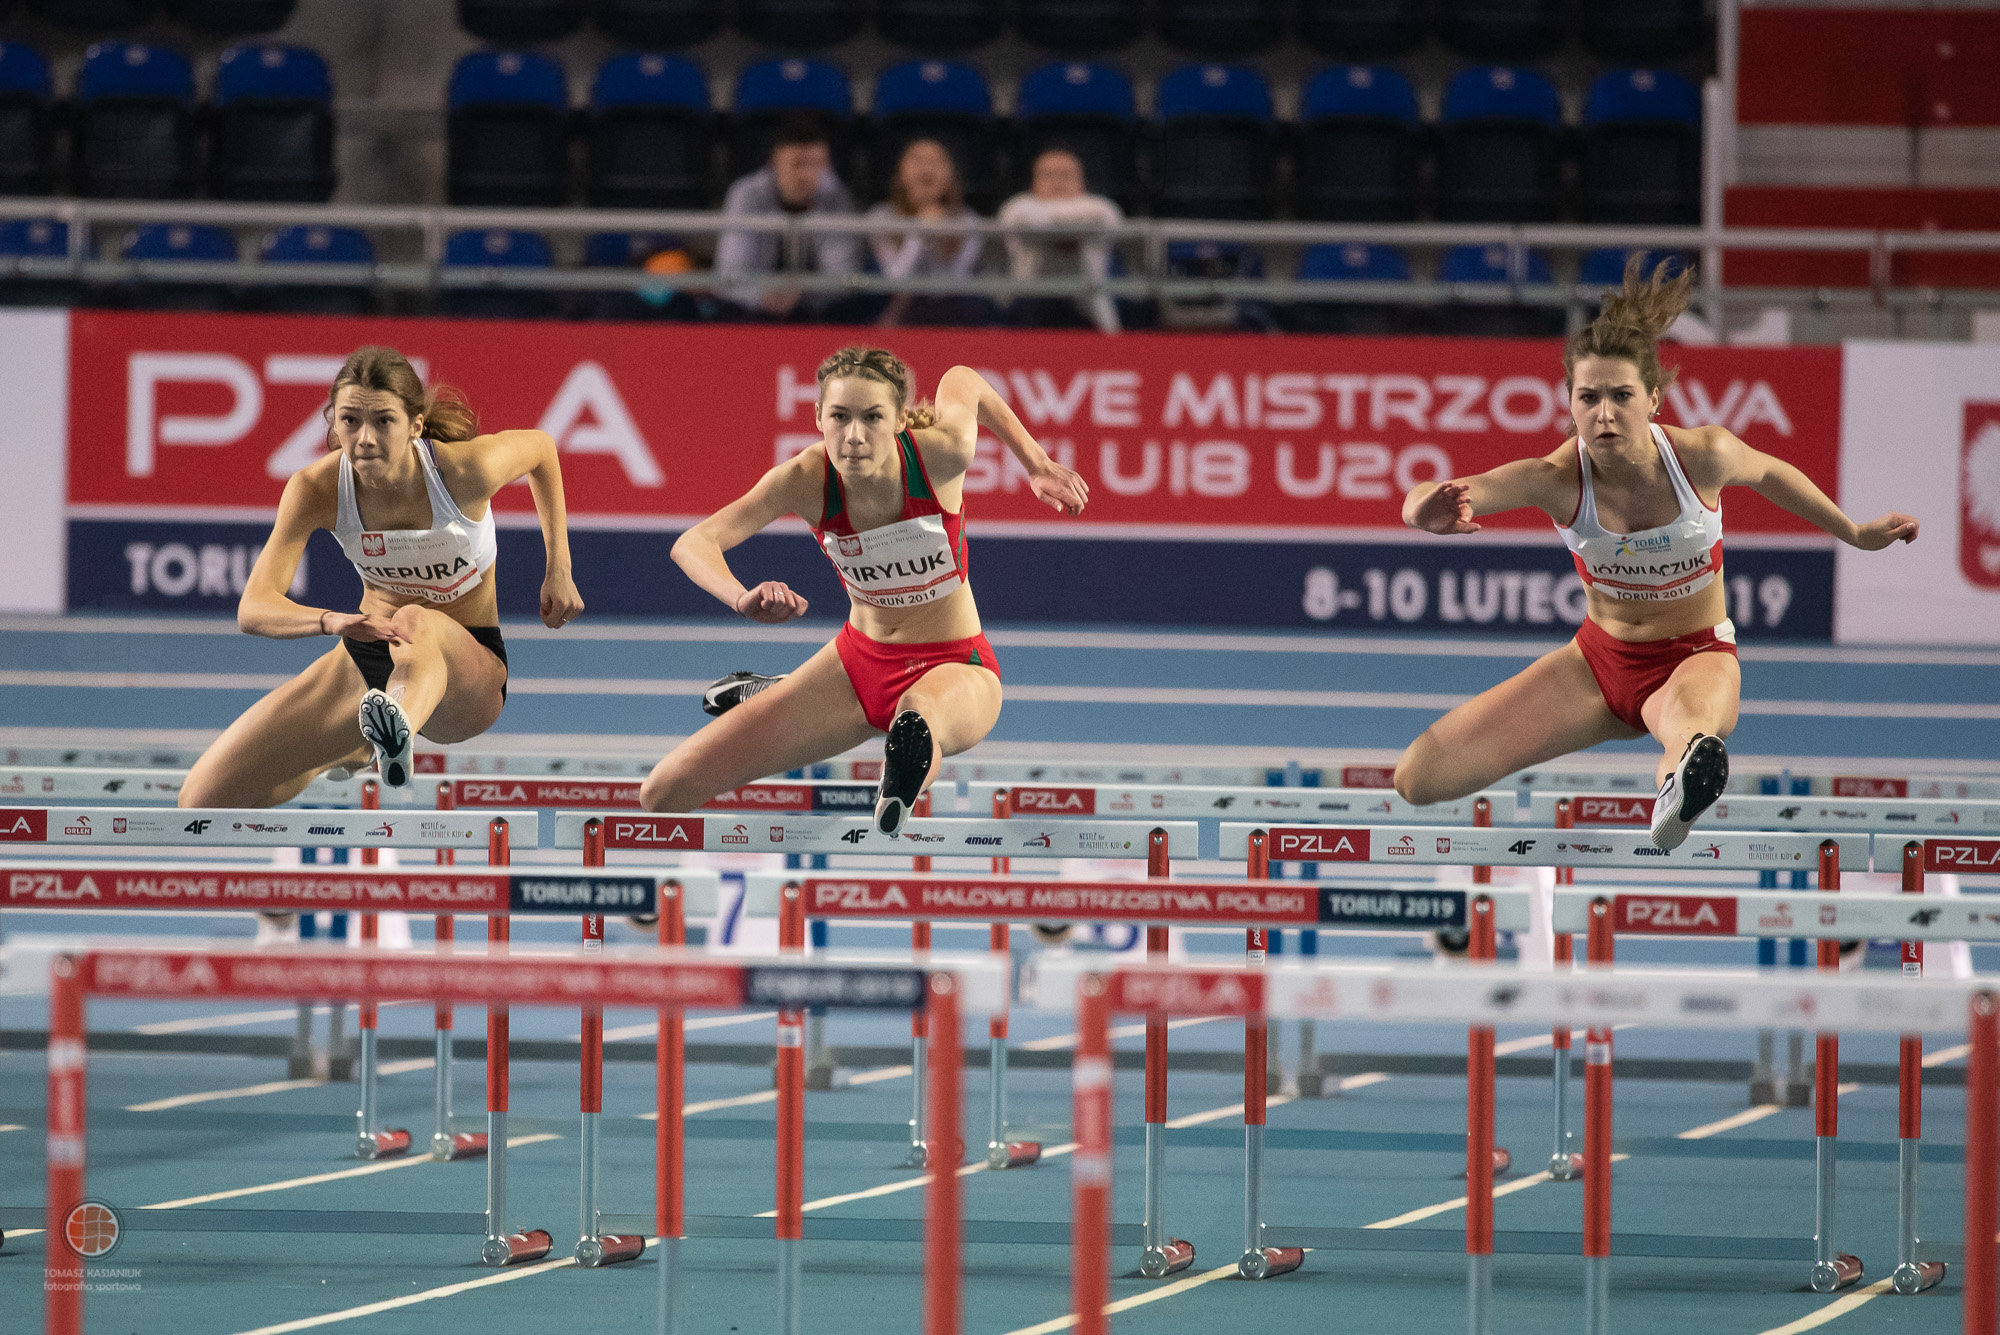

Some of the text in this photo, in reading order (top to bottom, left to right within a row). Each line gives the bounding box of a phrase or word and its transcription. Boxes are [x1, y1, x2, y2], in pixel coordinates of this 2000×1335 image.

[1162, 371, 1794, 437] MISTRZOWA
[127, 352, 666, 488] PZA
[1100, 439, 1252, 498] U18
[1275, 441, 1453, 500] U20
[1633, 533, 1670, 548] TORUŃ
[357, 556, 469, 581] KIEPURA
[837, 551, 946, 582] KIRYLUK
[431, 590, 459, 602] 2019
[908, 589, 937, 605] 2019
[1303, 569, 1428, 622] 8-10
[1437, 571, 1588, 625] LUTEG
[1616, 585, 1692, 600] TORUŃ 2019
[463, 784, 528, 802] PZLA
[537, 786, 608, 801] HALOWE
[740, 790, 804, 804] POLSKI
[1019, 791, 1084, 809] PZLA
[1582, 801, 1647, 819] PZLA
[65, 827, 91, 835] ORLEN
[184, 819, 212, 835] 4F
[307, 826, 346, 836] 4MOVE
[420, 821, 439, 830] NESTLÉ
[615, 823, 689, 842] PZLA
[722, 836, 749, 844] ORLEN
[841, 829, 869, 844] 4F
[964, 836, 1003, 846] 4MOVE
[1280, 834, 1355, 854] PZLA
[1388, 847, 1415, 855] ORLEN
[1507, 840, 1537, 855] 4F
[1632, 846, 1671, 857] 4MOVE
[1748, 843, 1767, 852] NESTLÉ
[10, 873, 645, 906] PZLA HALOWE MISTRZOSTWA POLSKI TORUŃ 2019
[816, 882, 1456, 919] PZLA HALOWE MISTRZOSTWA POLSKI TORUŃ 2019
[1626, 901, 1720, 927] PZLA
